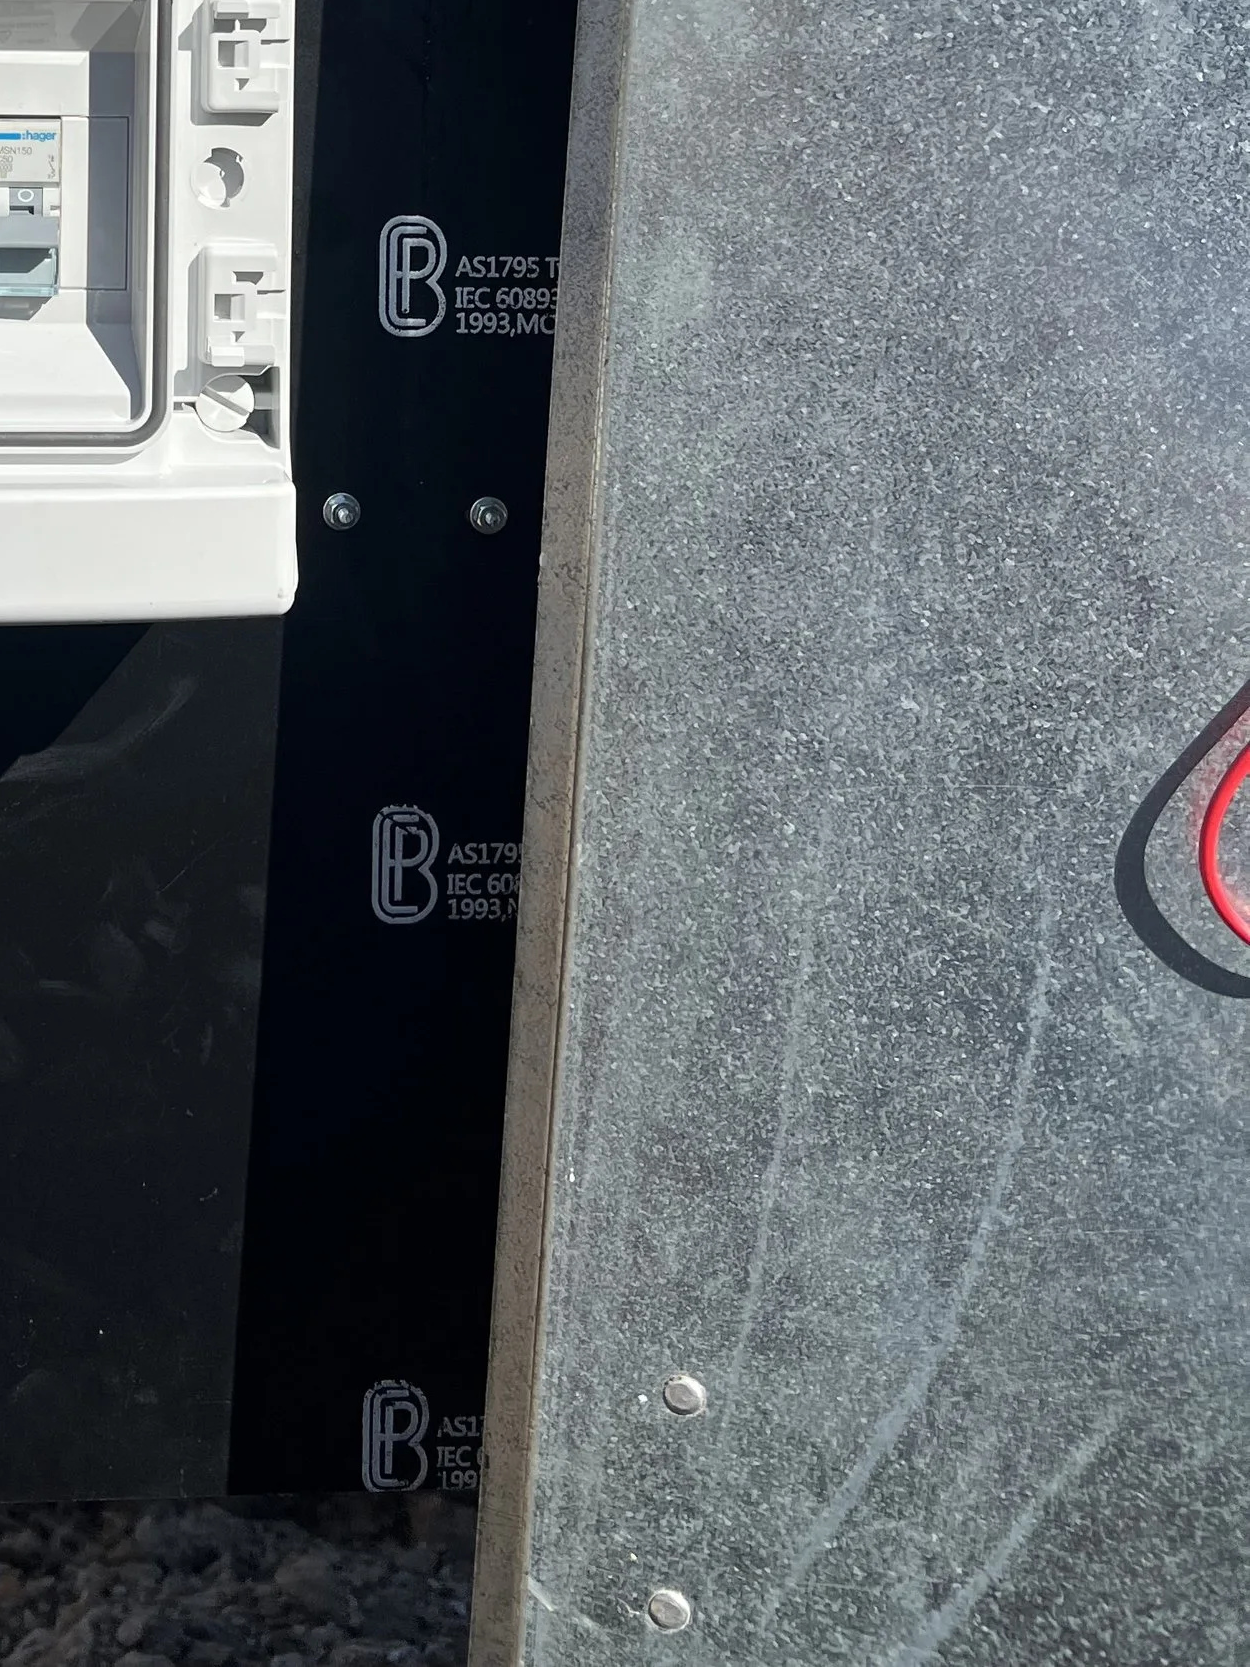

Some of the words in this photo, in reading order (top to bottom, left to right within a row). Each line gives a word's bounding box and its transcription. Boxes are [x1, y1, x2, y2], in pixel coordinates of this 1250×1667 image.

[455, 256, 540, 278] AS1795
[454, 287, 491, 309] IEC
[447, 843, 522, 865] AS179
[446, 873, 482, 895] IEC
[437, 1416, 485, 1437] AS1
[436, 1446, 472, 1468] IEC
